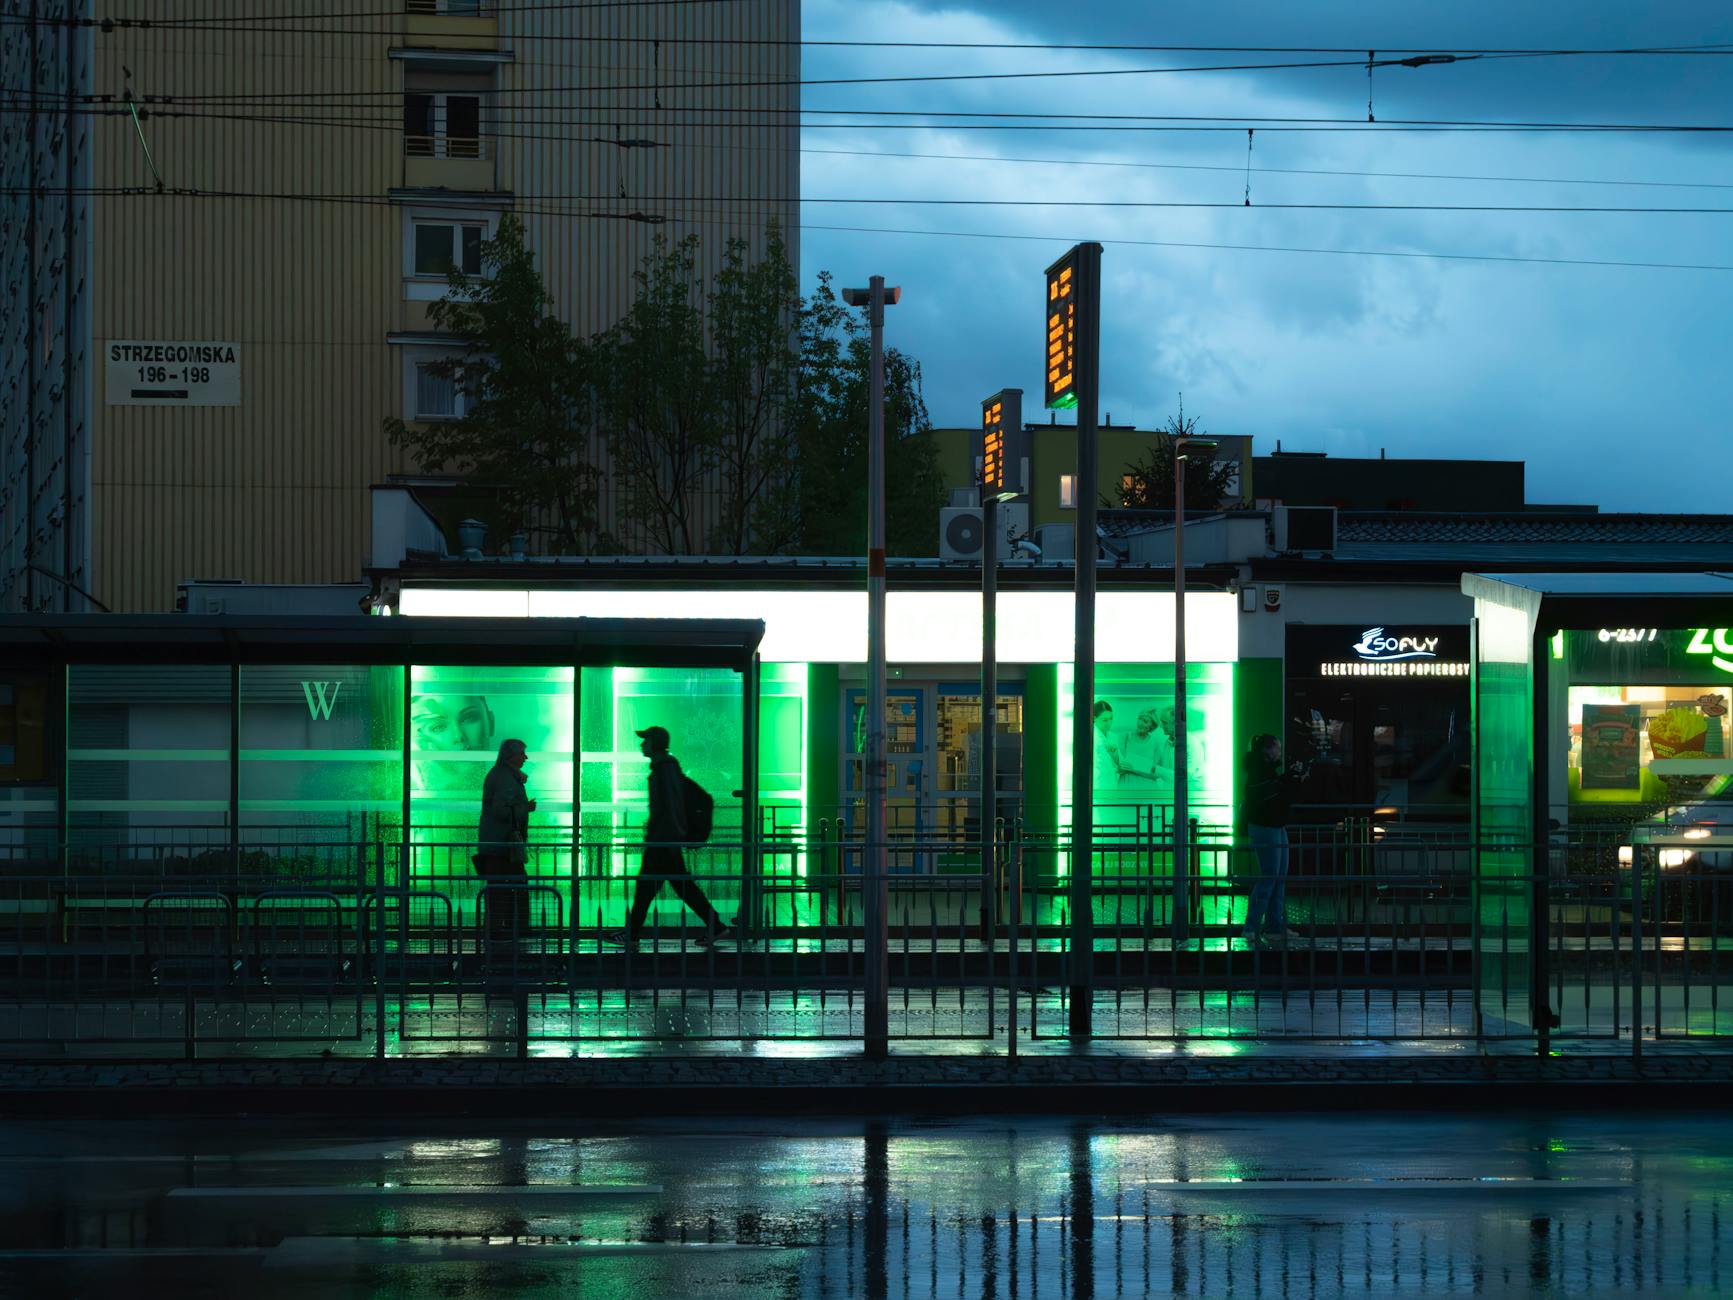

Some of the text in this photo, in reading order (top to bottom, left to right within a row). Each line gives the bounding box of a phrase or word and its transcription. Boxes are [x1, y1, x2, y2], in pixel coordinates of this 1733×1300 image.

[111, 345, 236, 363] STRZEGOMSKA
[1373, 637, 1439, 652] SOFLY
[1320, 662, 1470, 676] ELEKTRONICZNE PAPIEROSY
[301, 681, 342, 721] W
